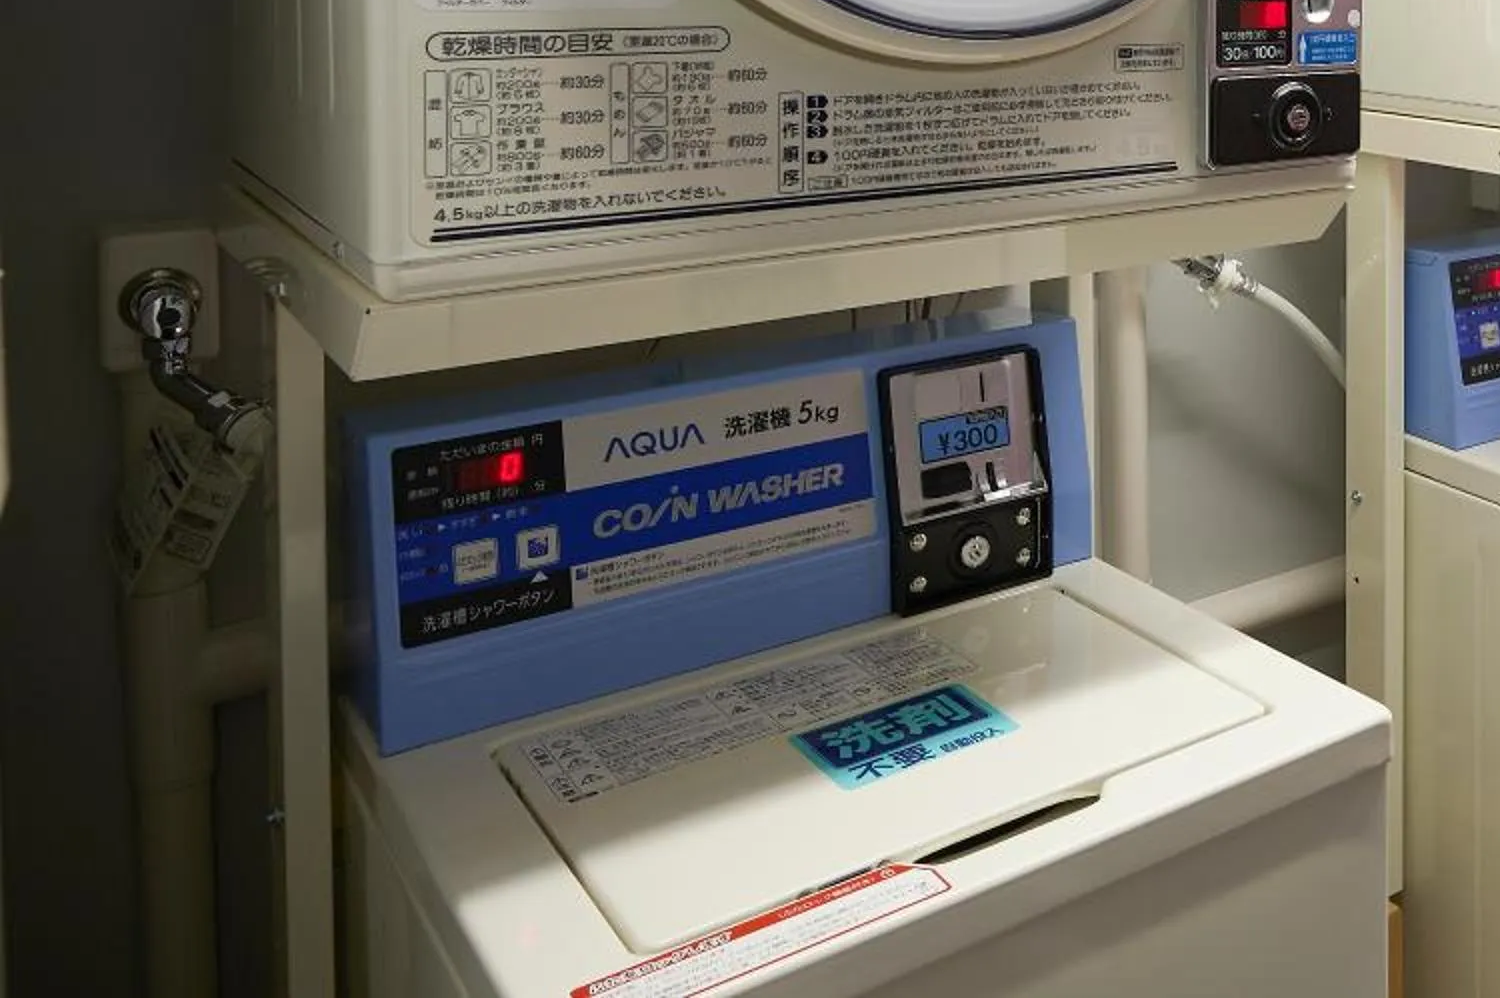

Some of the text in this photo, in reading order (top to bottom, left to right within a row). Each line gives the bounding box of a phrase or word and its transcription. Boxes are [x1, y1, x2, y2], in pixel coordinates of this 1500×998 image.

[442, 33, 613, 56] 乾燥時間の目安
[783, 98, 800, 187] 操作順序
[724, 400, 839, 439] 洗濯機 5kg
[604, 423, 705, 463] AQUA
[936, 423, 997, 456] ¥300
[501, 452, 522, 481] 0
[707, 463, 845, 514] WASHER
[423, 590, 556, 633] 洗濯槽シャワーボタン
[821, 694, 971, 759] 洗剤
[848, 744, 937, 780] 不要
